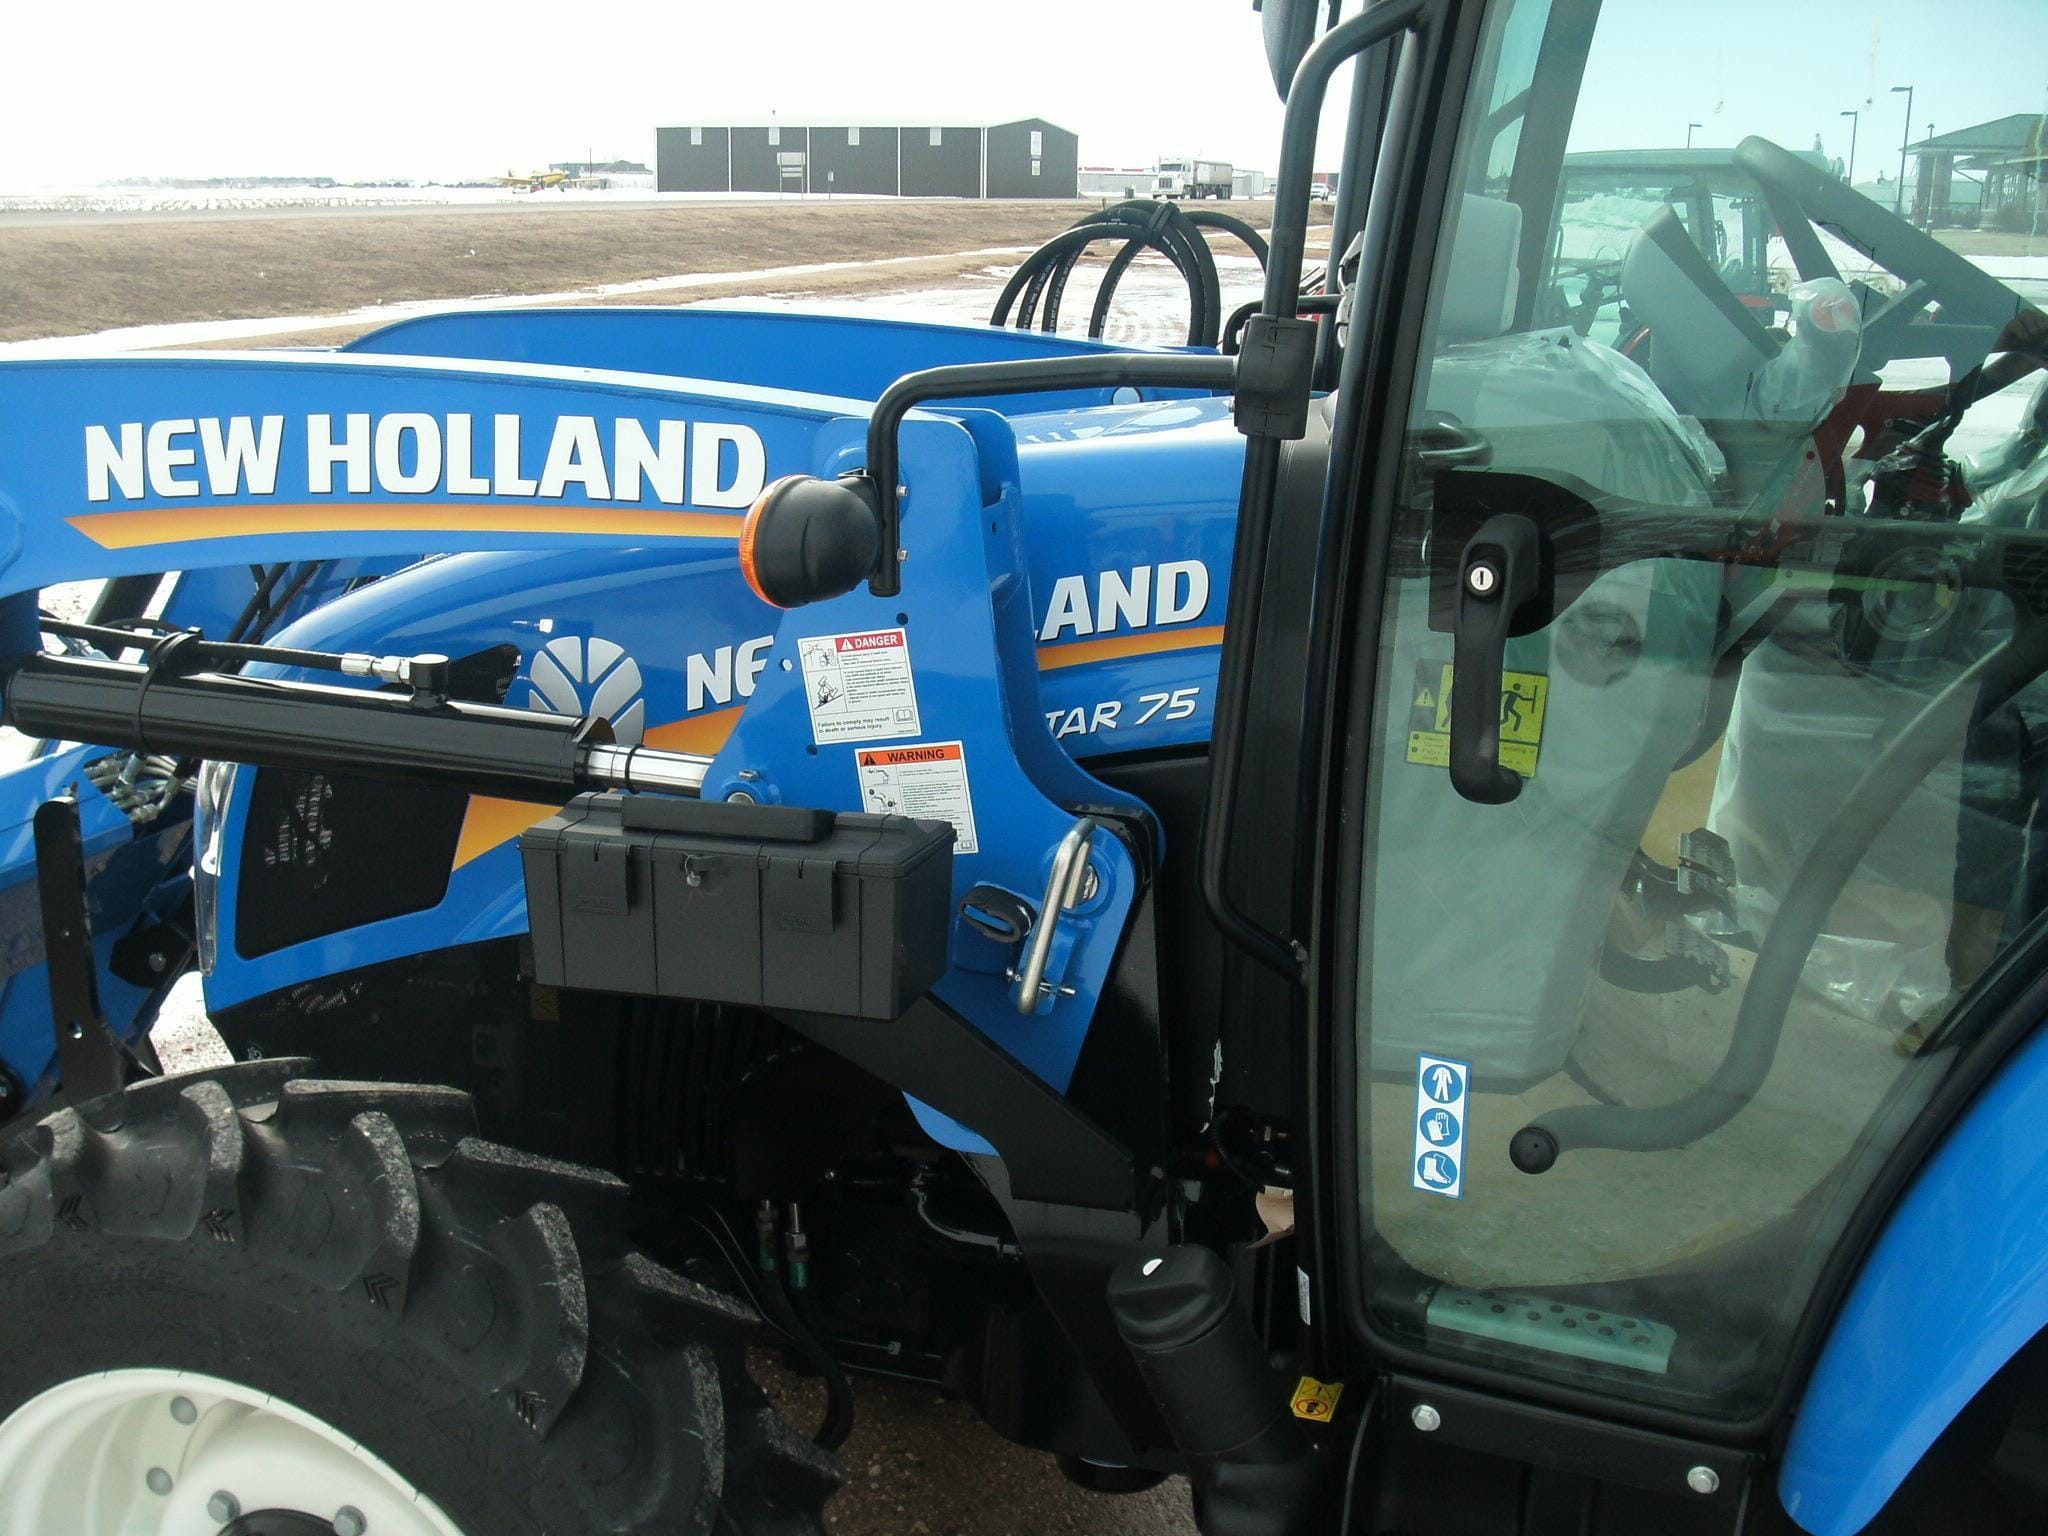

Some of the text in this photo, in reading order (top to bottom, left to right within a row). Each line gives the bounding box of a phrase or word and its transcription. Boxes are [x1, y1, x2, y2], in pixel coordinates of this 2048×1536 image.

[85, 412, 767, 508] NEW HOLLAND
[854, 634, 899, 649] DANGER
[1135, 687, 1200, 726] 75
[887, 748, 945, 763] WARNING
